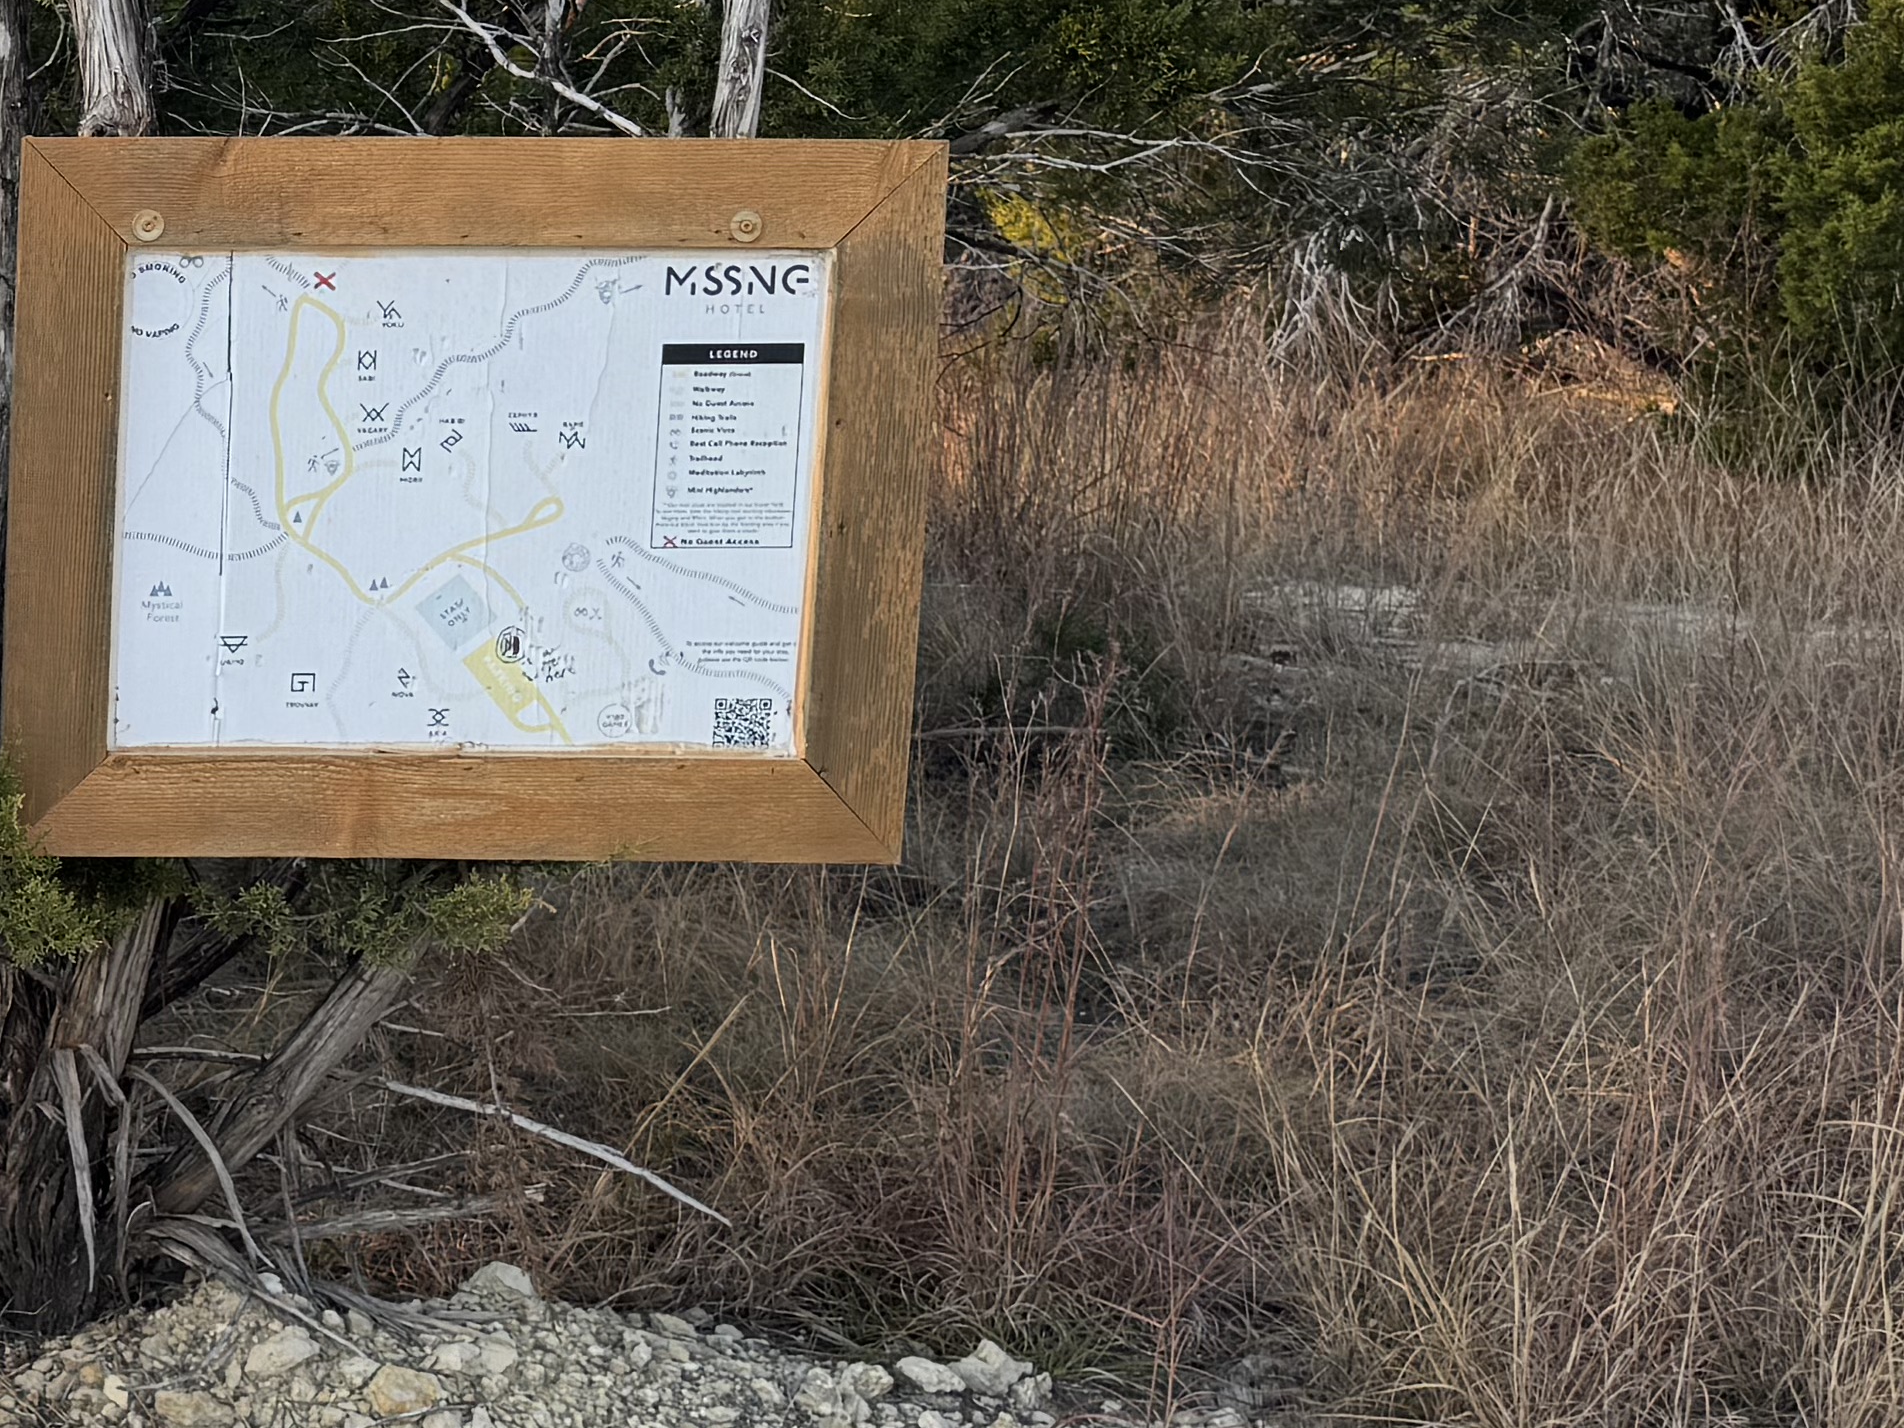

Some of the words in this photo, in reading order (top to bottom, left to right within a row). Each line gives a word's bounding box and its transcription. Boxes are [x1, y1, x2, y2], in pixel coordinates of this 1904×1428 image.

[138, 263, 186, 284] SMOKING
[705, 304, 765, 315] HOTEL
[709, 350, 758, 360] LEGEND
[141, 601, 184, 612] Mystical
[146, 613, 180, 623] Forest
